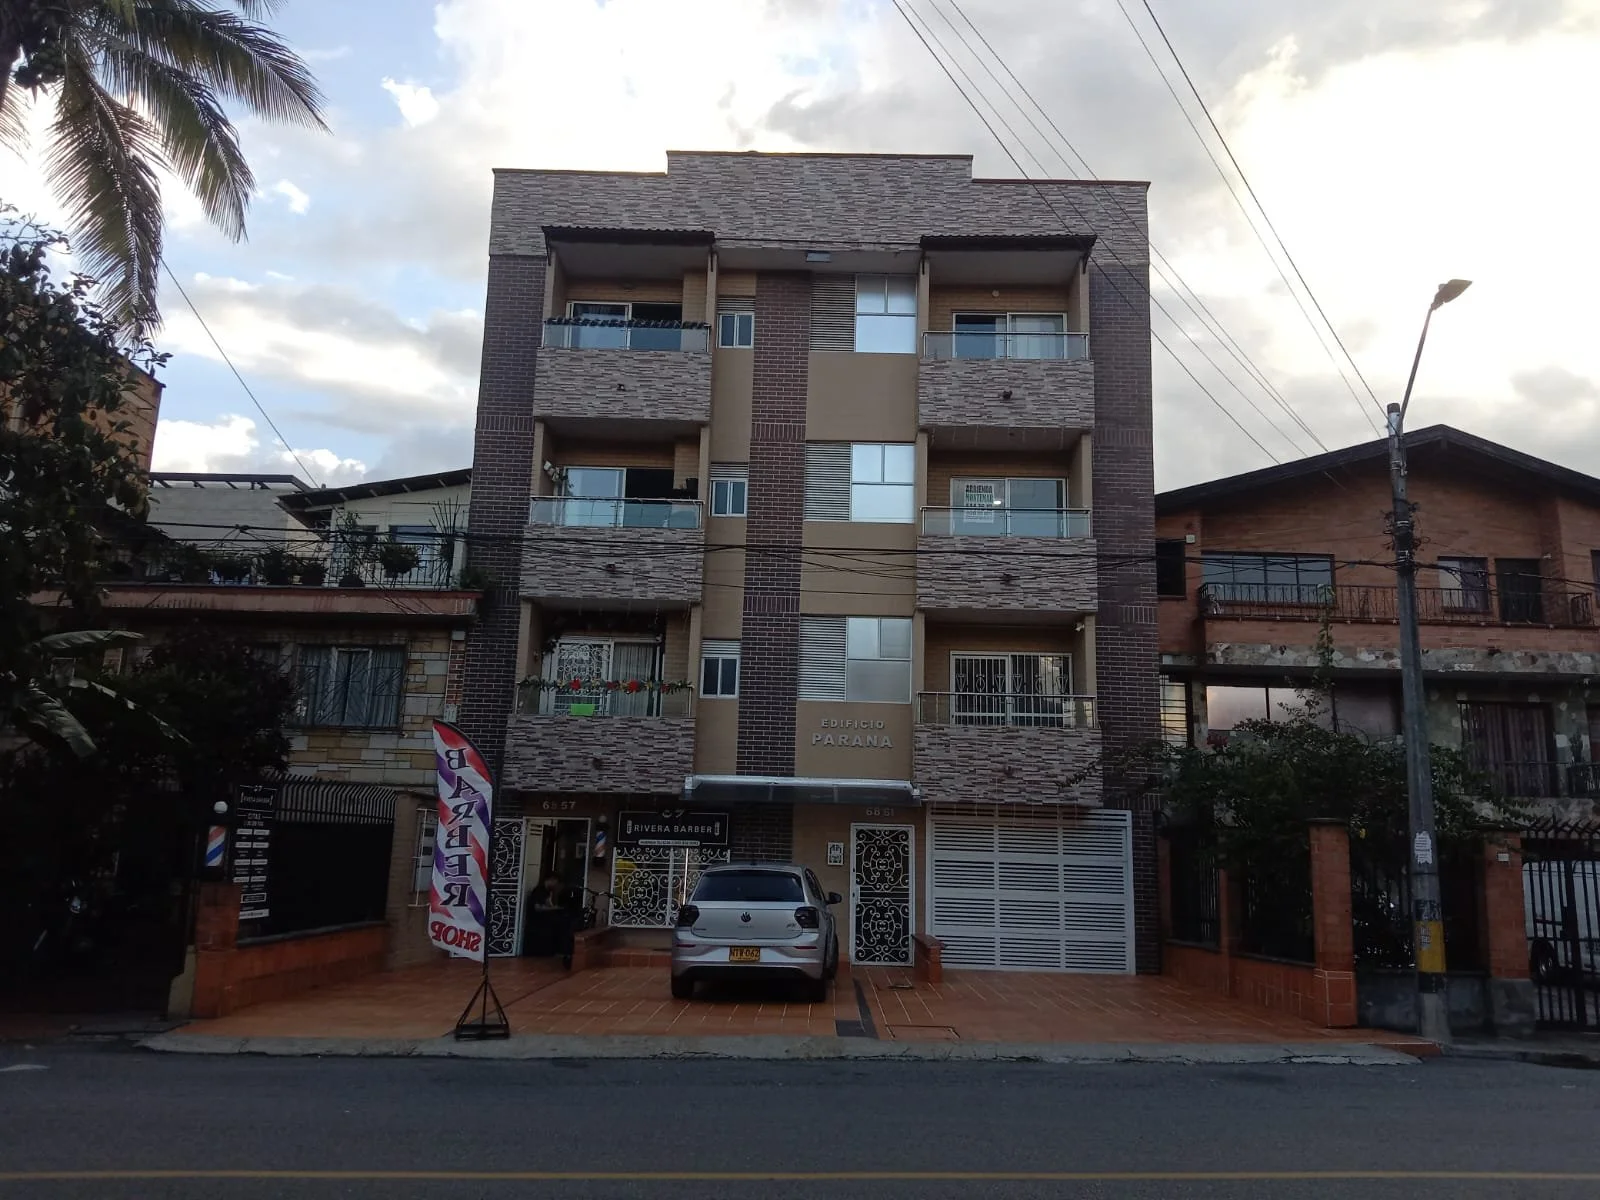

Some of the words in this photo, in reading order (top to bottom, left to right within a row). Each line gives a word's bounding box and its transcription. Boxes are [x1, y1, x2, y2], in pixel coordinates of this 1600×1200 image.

[821, 718, 885, 729] EDIFICIO
[812, 733, 894, 748] PARANA
[561, 801, 577, 810] 57
[634, 824, 670, 833] RIVERA
[673, 825, 712, 833] BARBER
